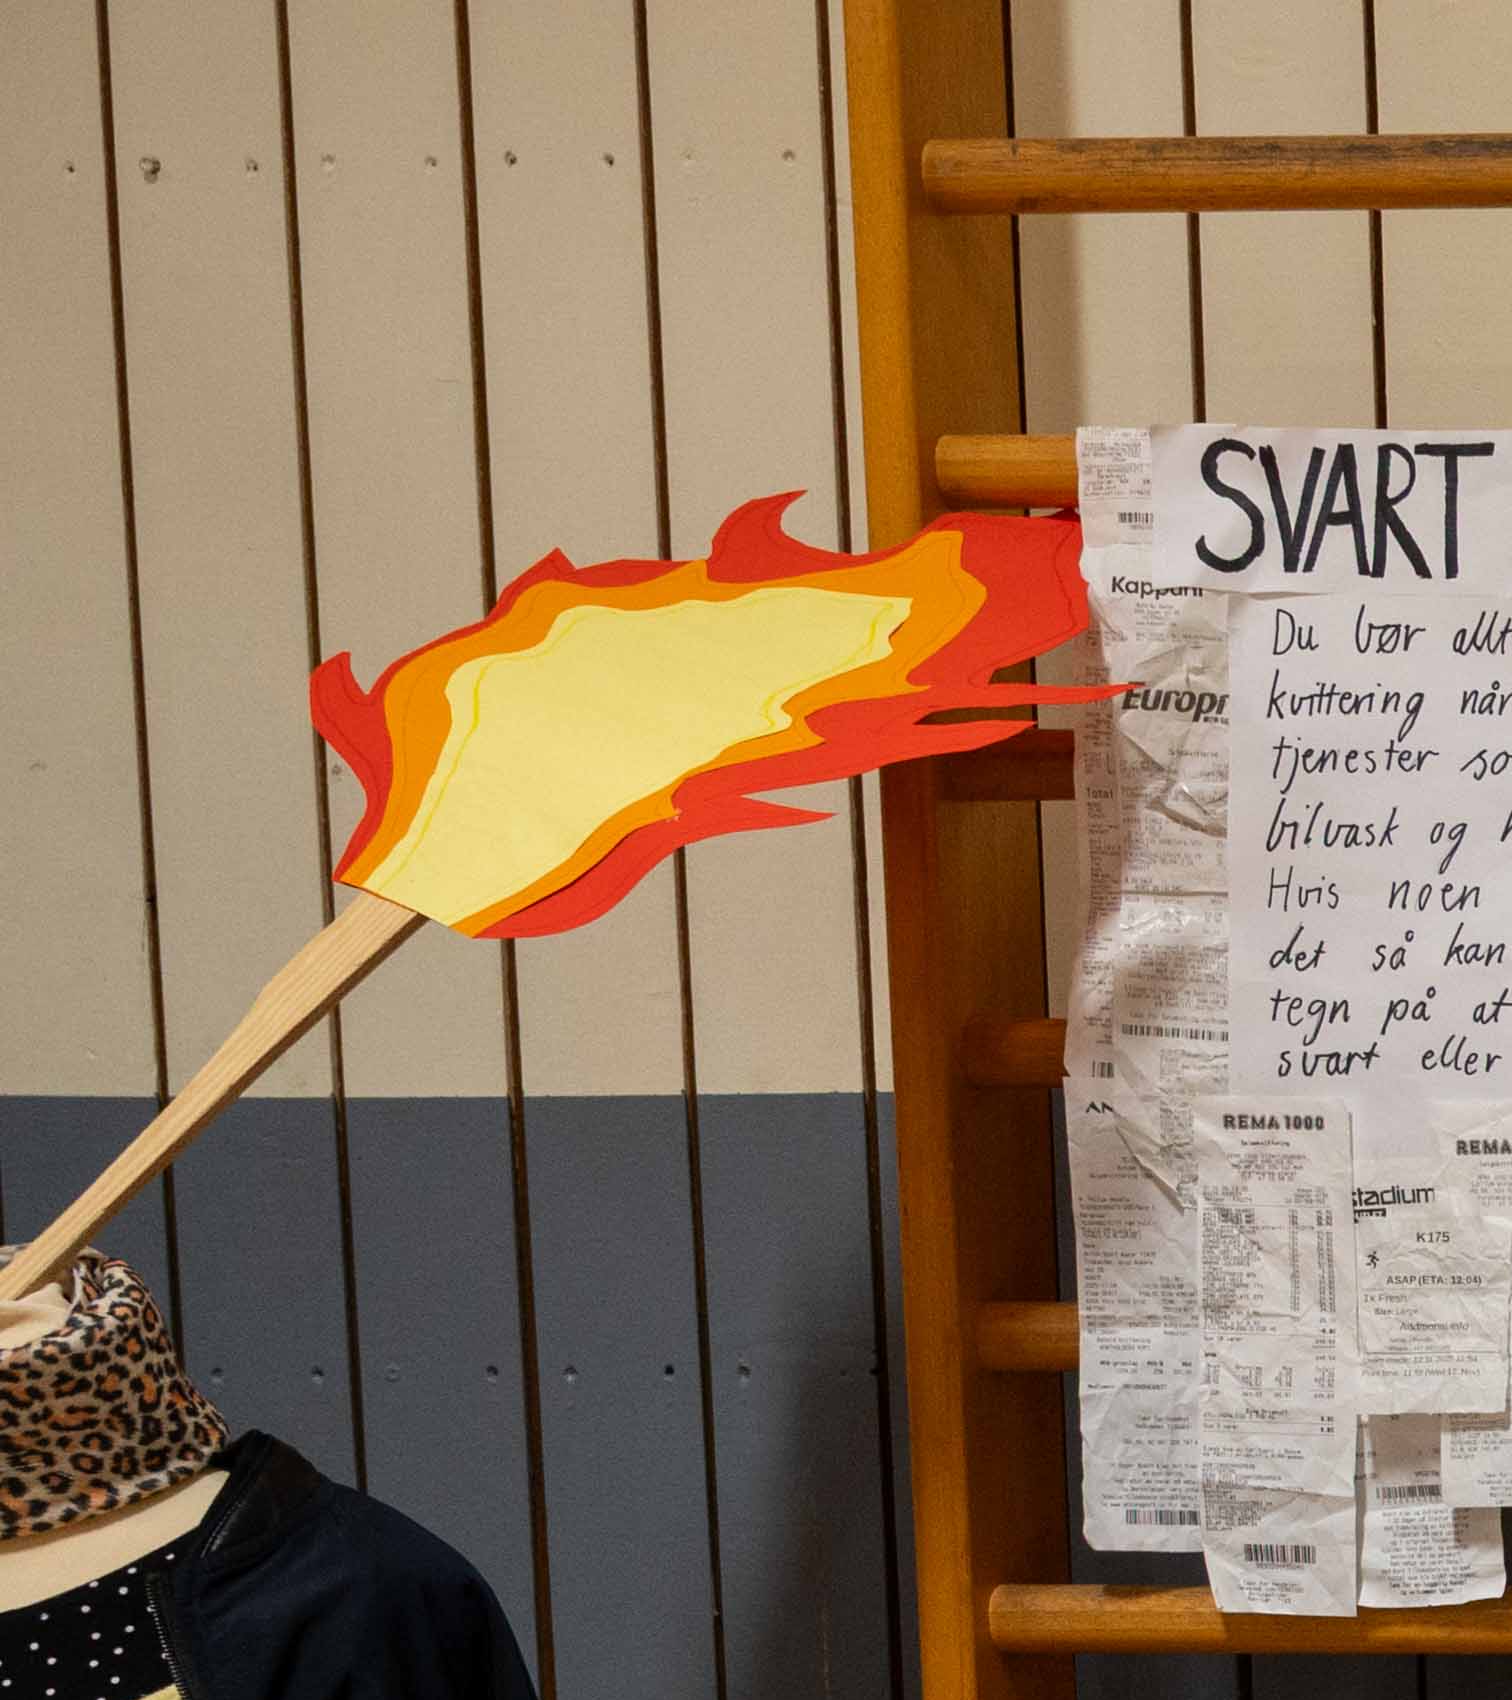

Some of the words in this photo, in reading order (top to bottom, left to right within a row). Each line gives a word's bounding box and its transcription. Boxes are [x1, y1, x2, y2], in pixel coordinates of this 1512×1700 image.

[1196, 441, 1494, 578] SVART
[1273, 608, 1319, 655] Du
[1355, 604, 1426, 654] bør
[1267, 669, 1424, 743] kvittering
[1273, 736, 1439, 795] tjenester
[1266, 798, 1399, 852] bilvask
[1430, 822, 1467, 868] og
[1268, 866, 1339, 912] Hvis
[1388, 880, 1480, 912] noen
[1269, 938, 1325, 972] det
[1372, 930, 1414, 971] så
[1444, 935, 1505, 966] kan
[1270, 989, 1350, 1046] tegn
[1380, 986, 1436, 1042] på
[1278, 1042, 1380, 1077] svart
[1421, 1042, 1502, 1075] eller
[1223, 1114, 1280, 1130] REMA
[1284, 1115, 1324, 1130] 1000
[1456, 1139, 1512, 1155] REMA
[1416, 1231, 1450, 1243] K175
[1387, 1275, 1416, 1284] ASAP
